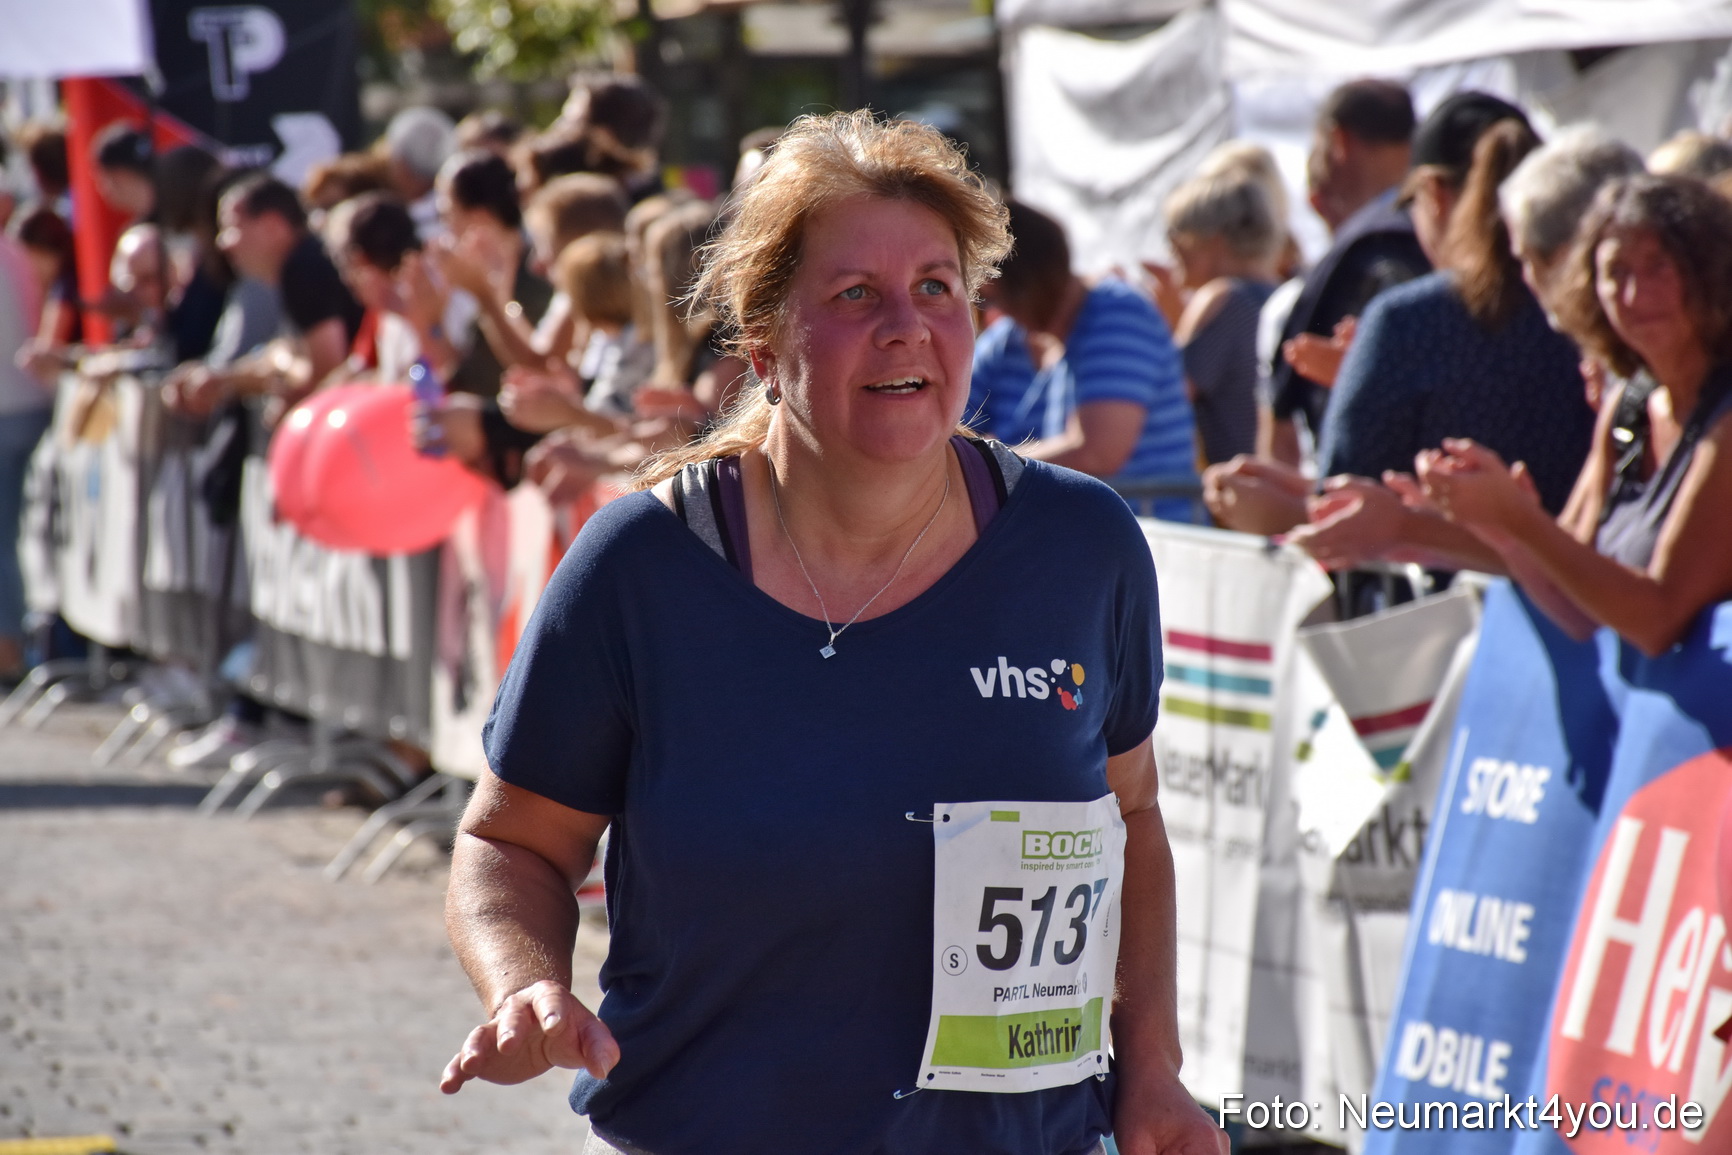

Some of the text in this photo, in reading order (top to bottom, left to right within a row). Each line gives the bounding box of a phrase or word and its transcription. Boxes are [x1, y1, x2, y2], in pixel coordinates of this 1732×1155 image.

[970, 656, 1050, 700] vhs
[1460, 756, 1552, 825] STORE
[1020, 861, 1054, 872] inspired
[1055, 861, 1065, 872] by
[1065, 861, 1084, 871] smart
[993, 984, 1030, 1002] PARTL
